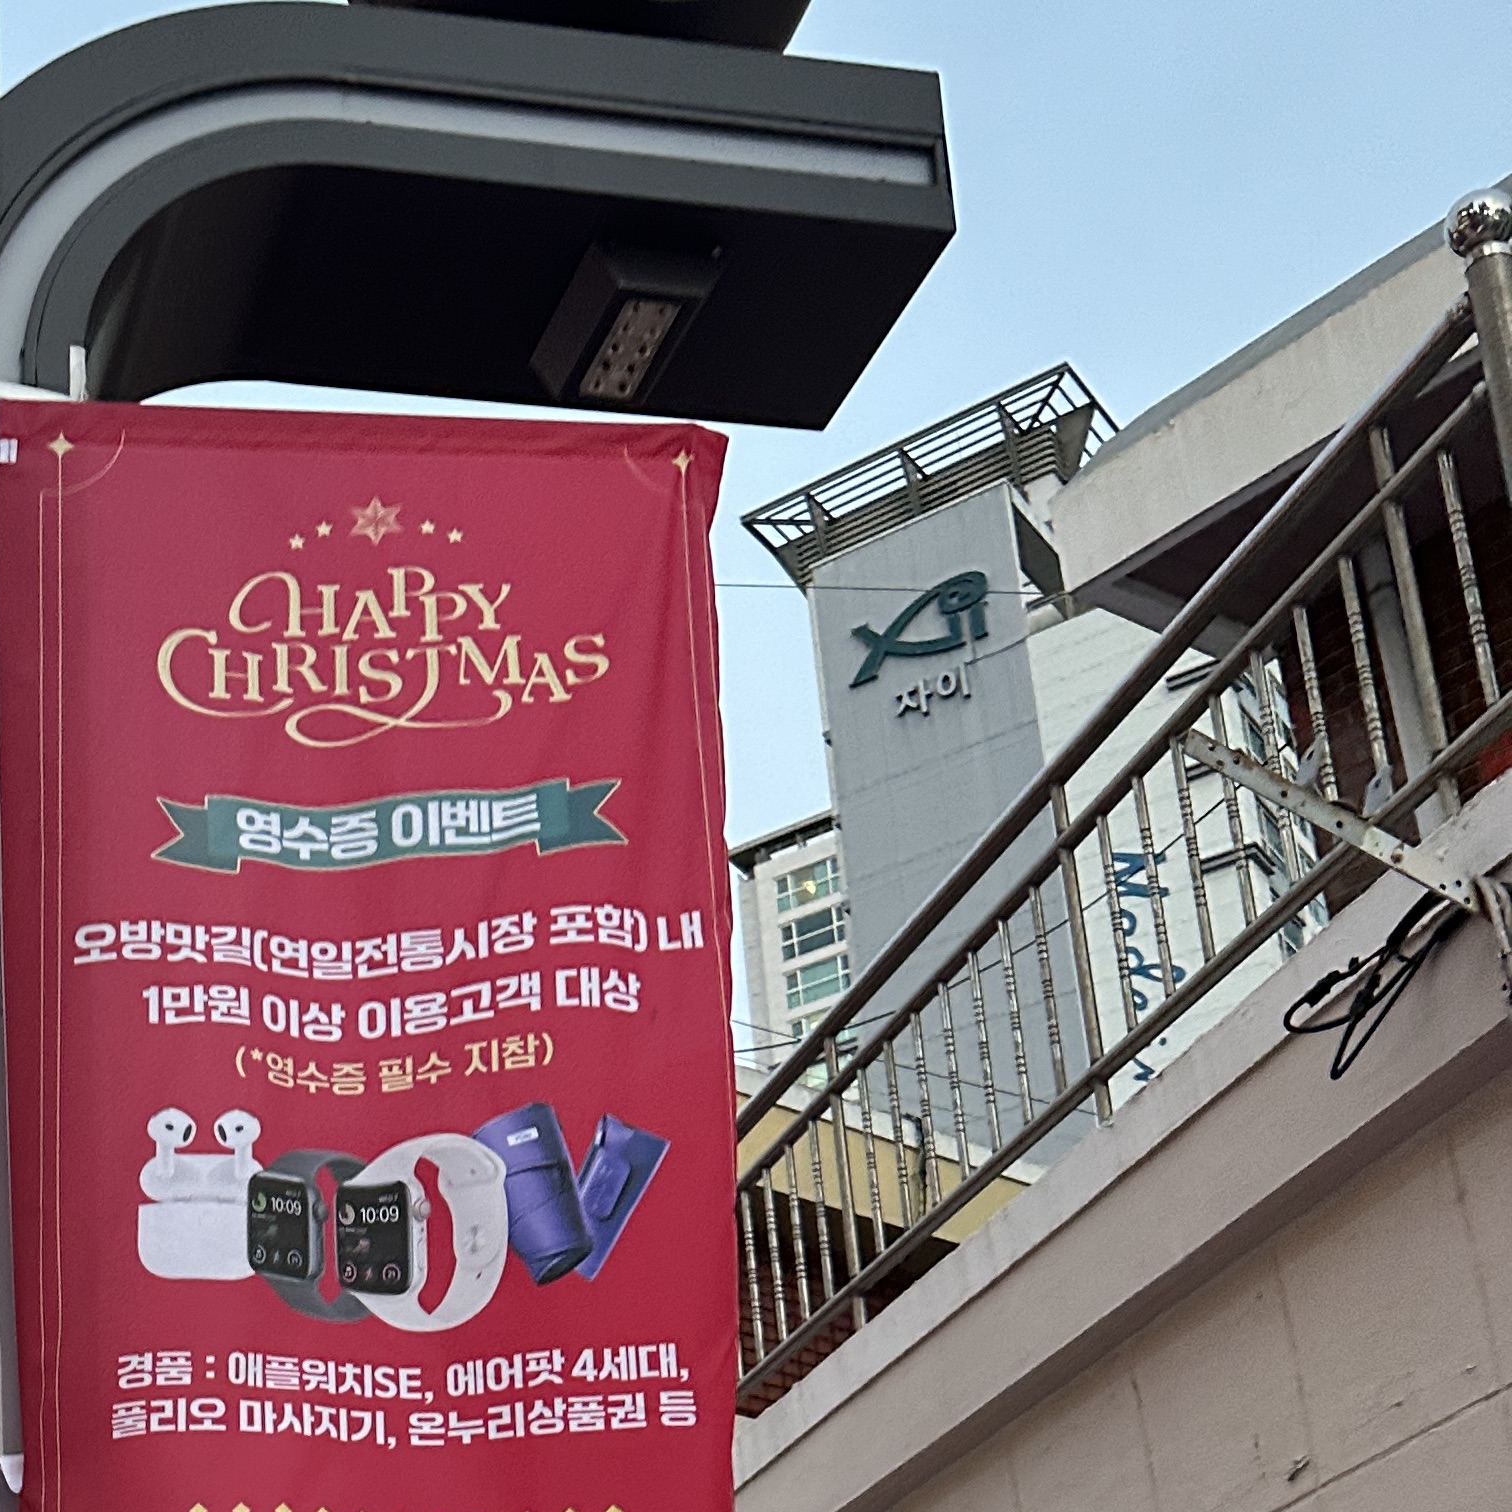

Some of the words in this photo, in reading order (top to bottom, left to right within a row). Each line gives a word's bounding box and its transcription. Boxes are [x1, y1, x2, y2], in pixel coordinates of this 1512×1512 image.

[227, 566, 511, 644] HAPPY
[157, 628, 610, 748] CHRISTMAS
[896, 664, 971, 717] 자이
[236, 804, 379, 861] 영수증
[391, 792, 541, 847] 이벤트
[73, 914, 536, 981] 오방맛길(연일전통시장
[549, 903, 648, 952] 포함)
[658, 909, 704, 952] 내
[142, 984, 250, 1026] 1만원
[262, 992, 345, 1042] 이상
[358, 970, 541, 1040] 이용고객
[555, 967, 641, 1013] 대상
[379, 1053, 453, 1093] 필수
[465, 1032, 555, 1076] 지참)
[271, 1197, 302, 1216] 10:09
[360, 1205, 399, 1224] 10:09
[116, 1352, 193, 1391] 경품
[228, 1351, 433, 1403] 애플워치SE,
[446, 1350, 565, 1397] 에어팟
[572, 1342, 690, 1385] 4세대,
[111, 1397, 227, 1441] 풀리오
[239, 1400, 396, 1450] 마사지기,
[408, 1396, 647, 1446] 온누리상품권
[660, 1389, 698, 1428] 등
